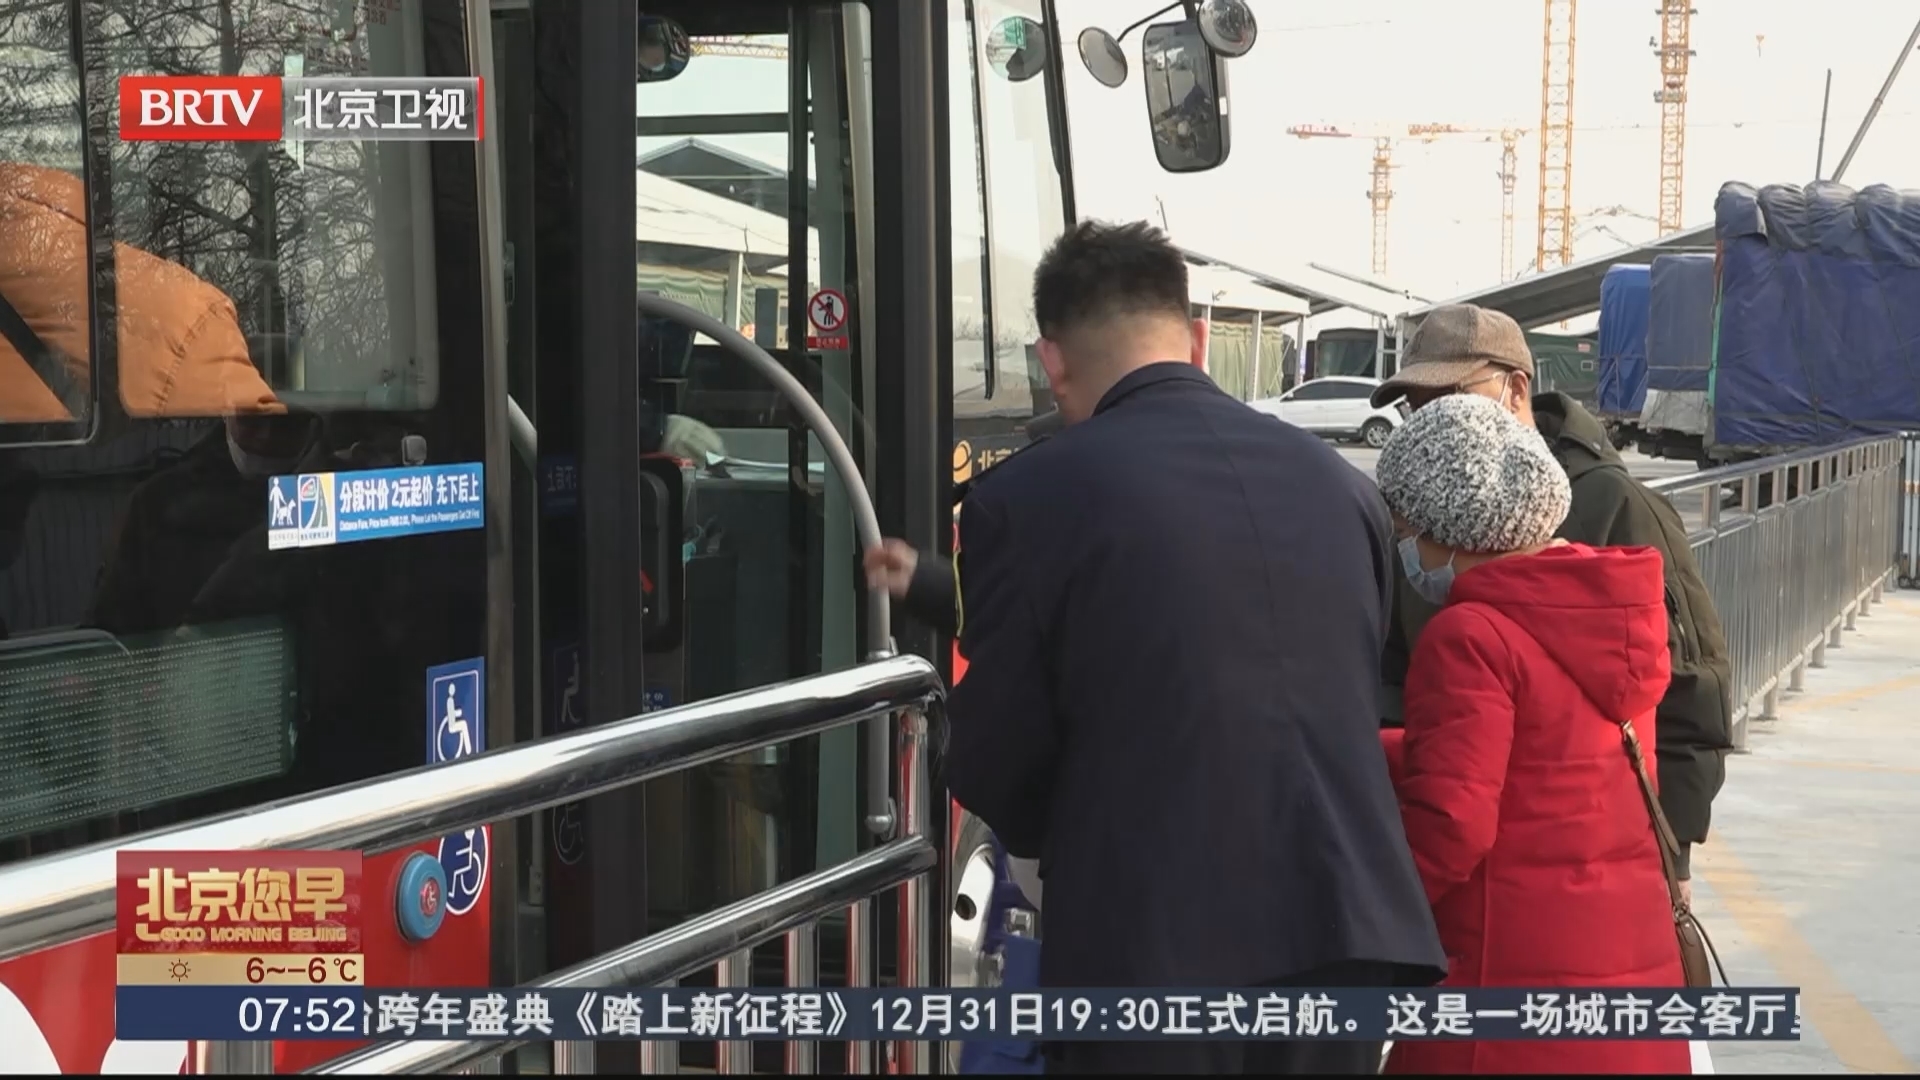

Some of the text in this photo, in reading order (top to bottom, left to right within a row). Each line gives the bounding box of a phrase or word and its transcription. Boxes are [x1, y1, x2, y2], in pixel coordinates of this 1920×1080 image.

[340, 473, 480, 513] 分段计价 2元起价 先下后上
